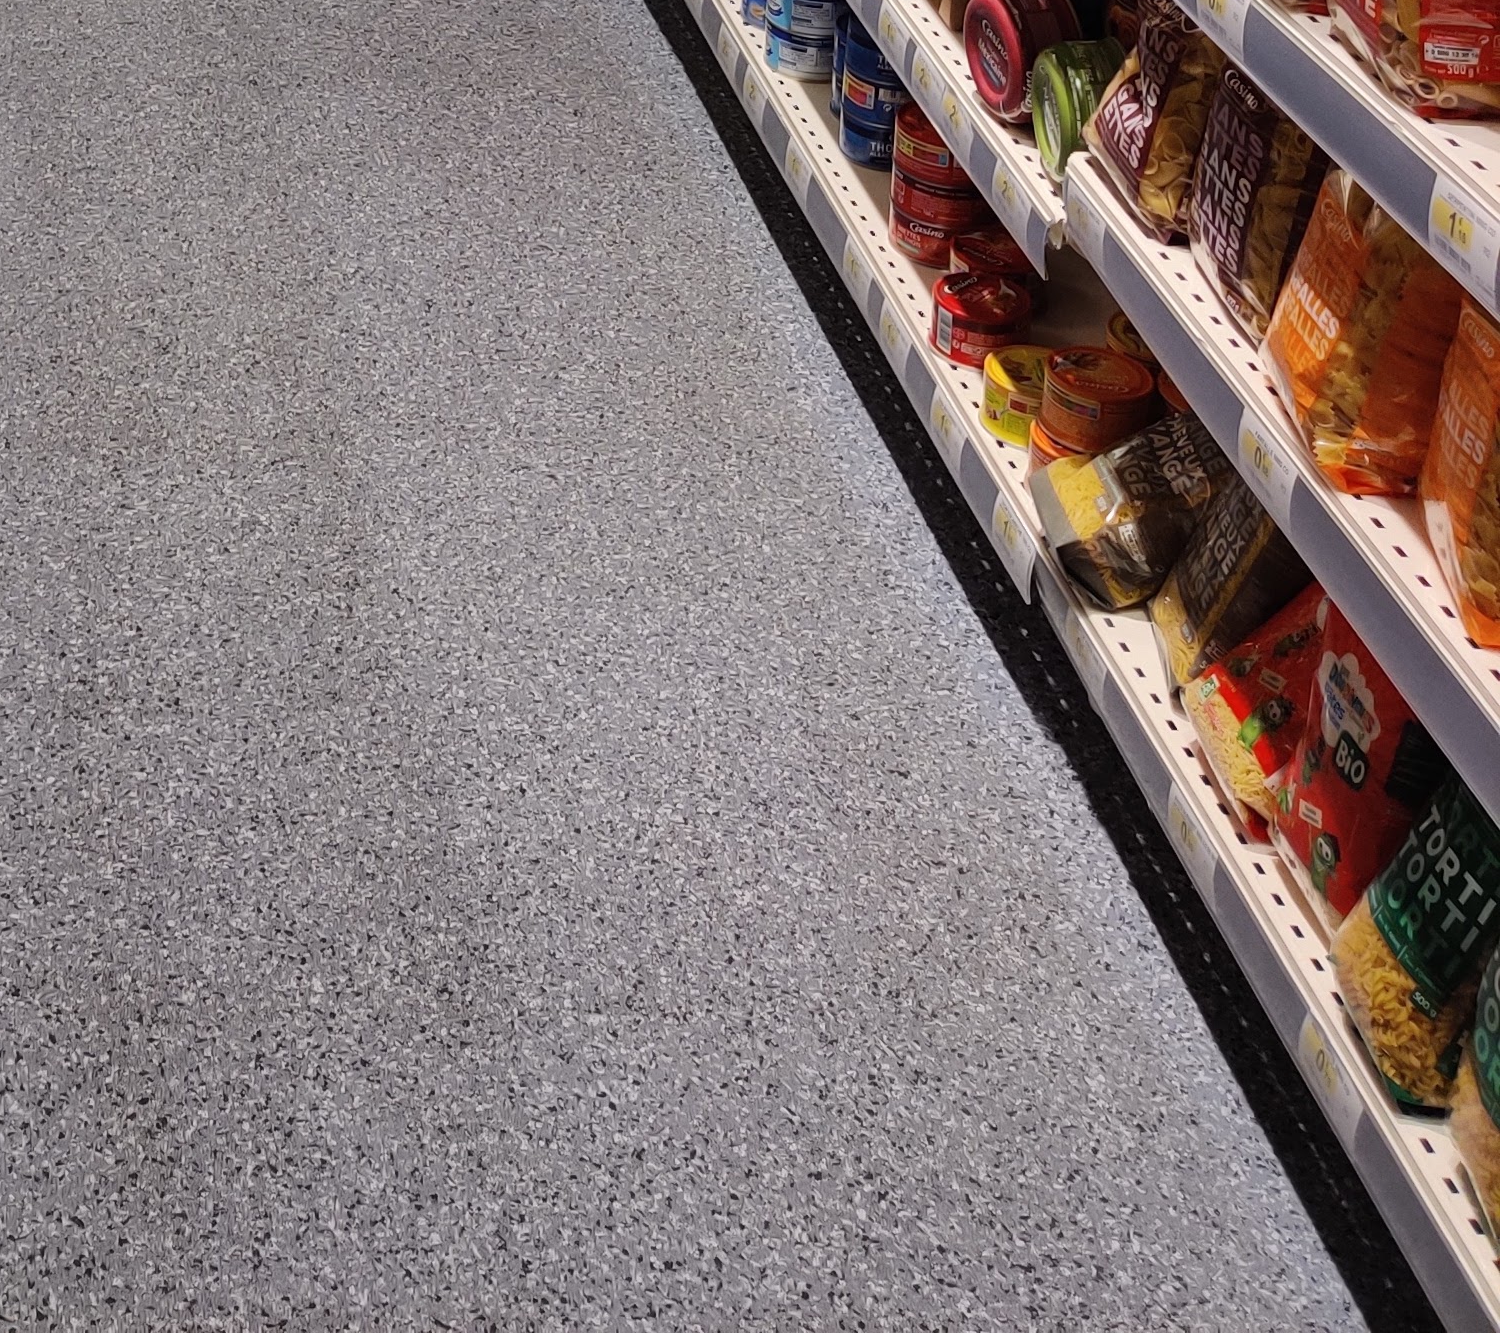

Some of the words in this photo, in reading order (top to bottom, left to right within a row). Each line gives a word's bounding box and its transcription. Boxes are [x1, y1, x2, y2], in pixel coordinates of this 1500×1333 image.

[980, 18, 1010, 61] Casino
[1222, 68, 1260, 111] Casino
[1334, 744, 1365, 786] BiO
[1419, 805, 1497, 926] TORTI
